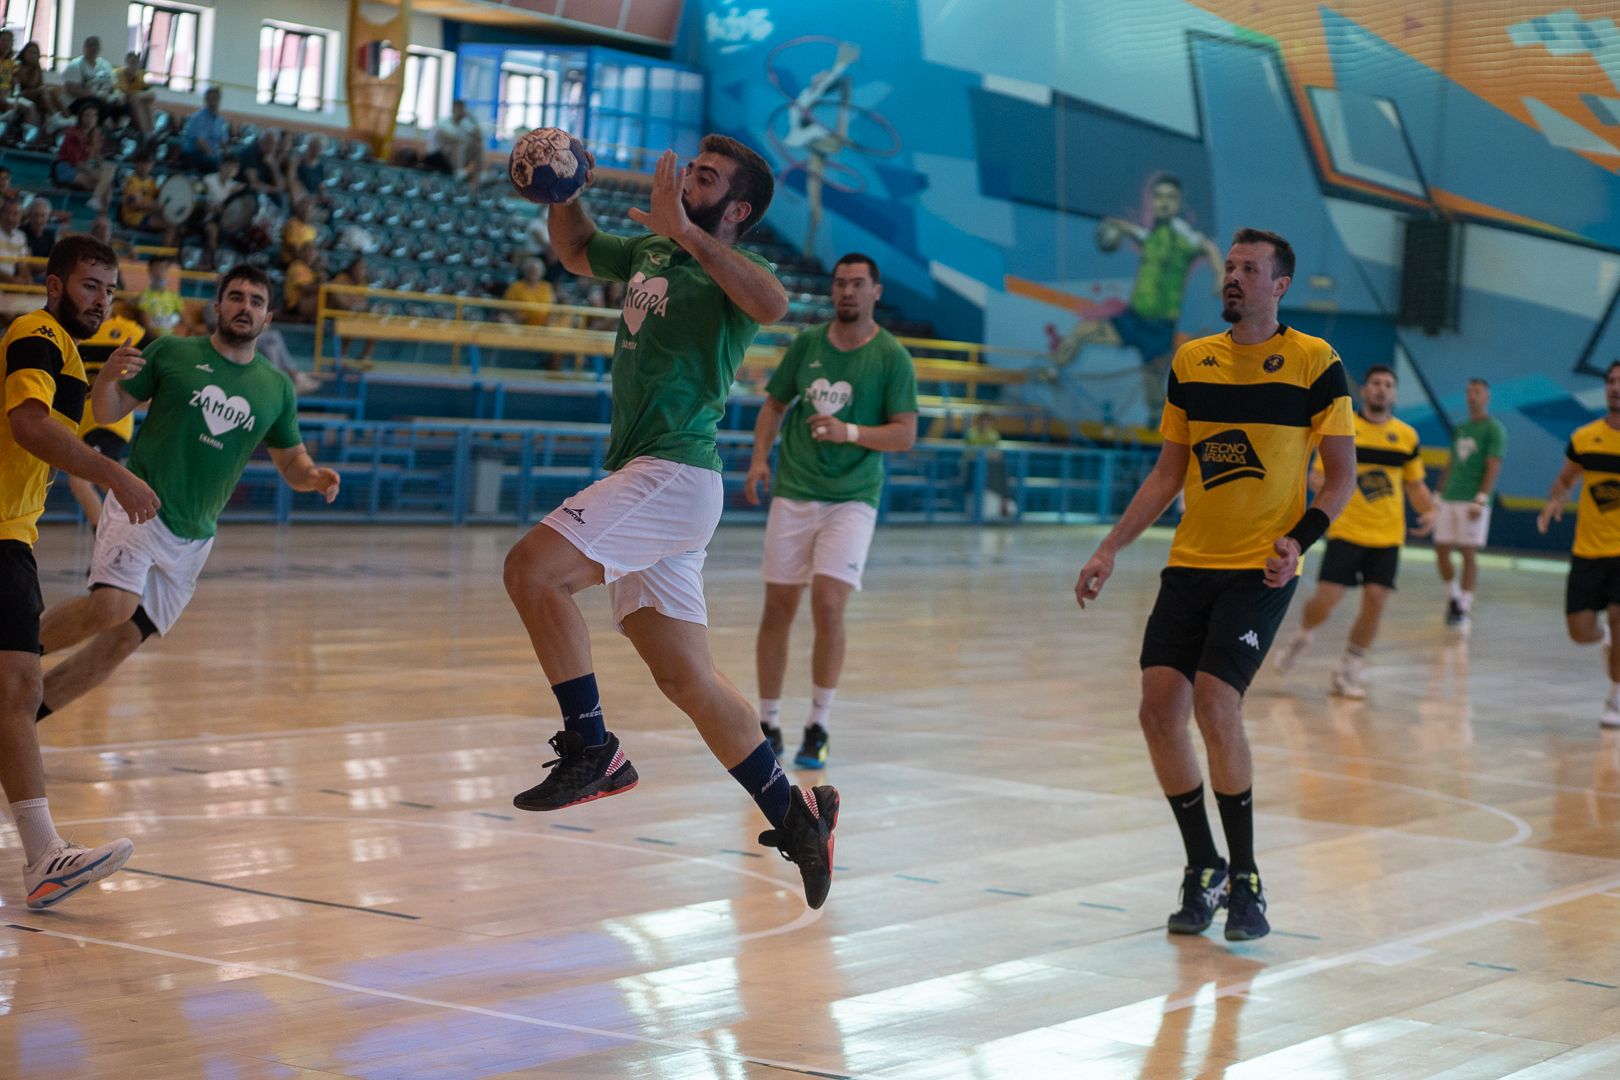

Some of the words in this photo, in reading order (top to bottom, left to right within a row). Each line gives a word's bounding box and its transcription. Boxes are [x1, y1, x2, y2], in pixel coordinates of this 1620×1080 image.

[189, 390, 256, 432] ZAMORA
[1204, 442, 1248, 454] TECNO
[1202, 452, 1246, 465] ARANDA
